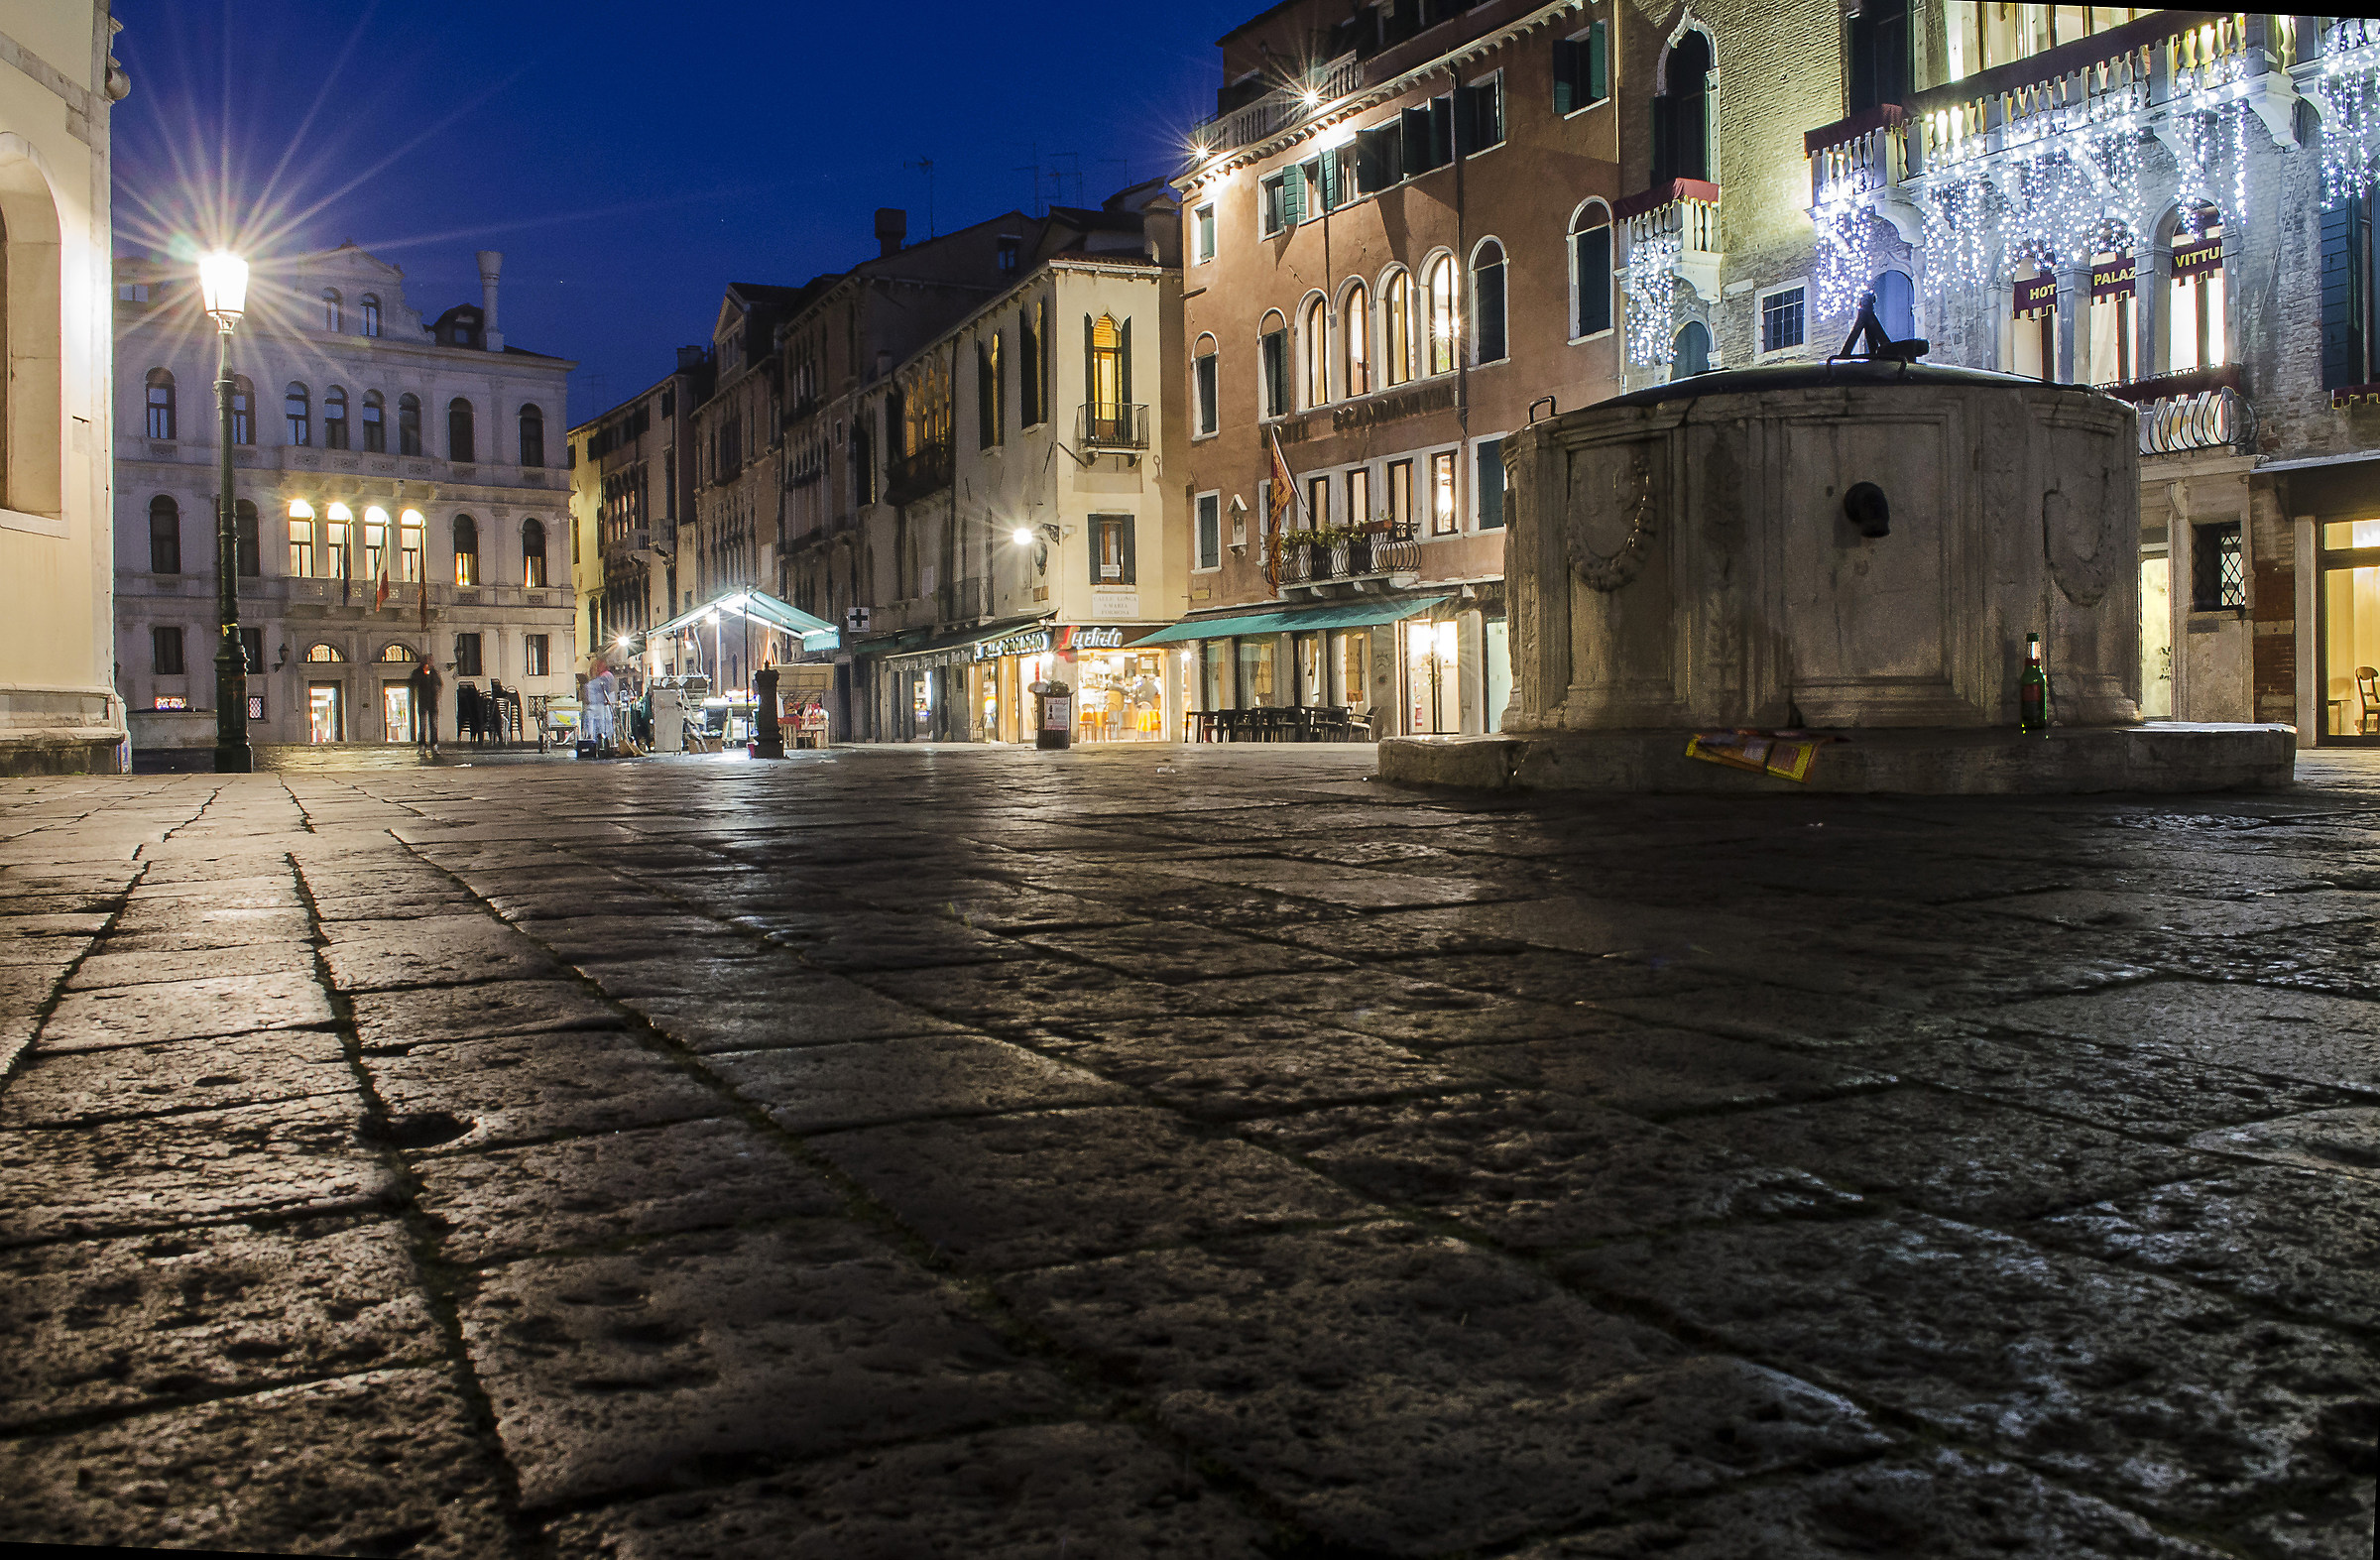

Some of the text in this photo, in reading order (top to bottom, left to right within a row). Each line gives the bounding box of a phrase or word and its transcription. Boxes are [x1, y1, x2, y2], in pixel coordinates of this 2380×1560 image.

[2029, 246, 2223, 300] HOT PALAZ VITTU
